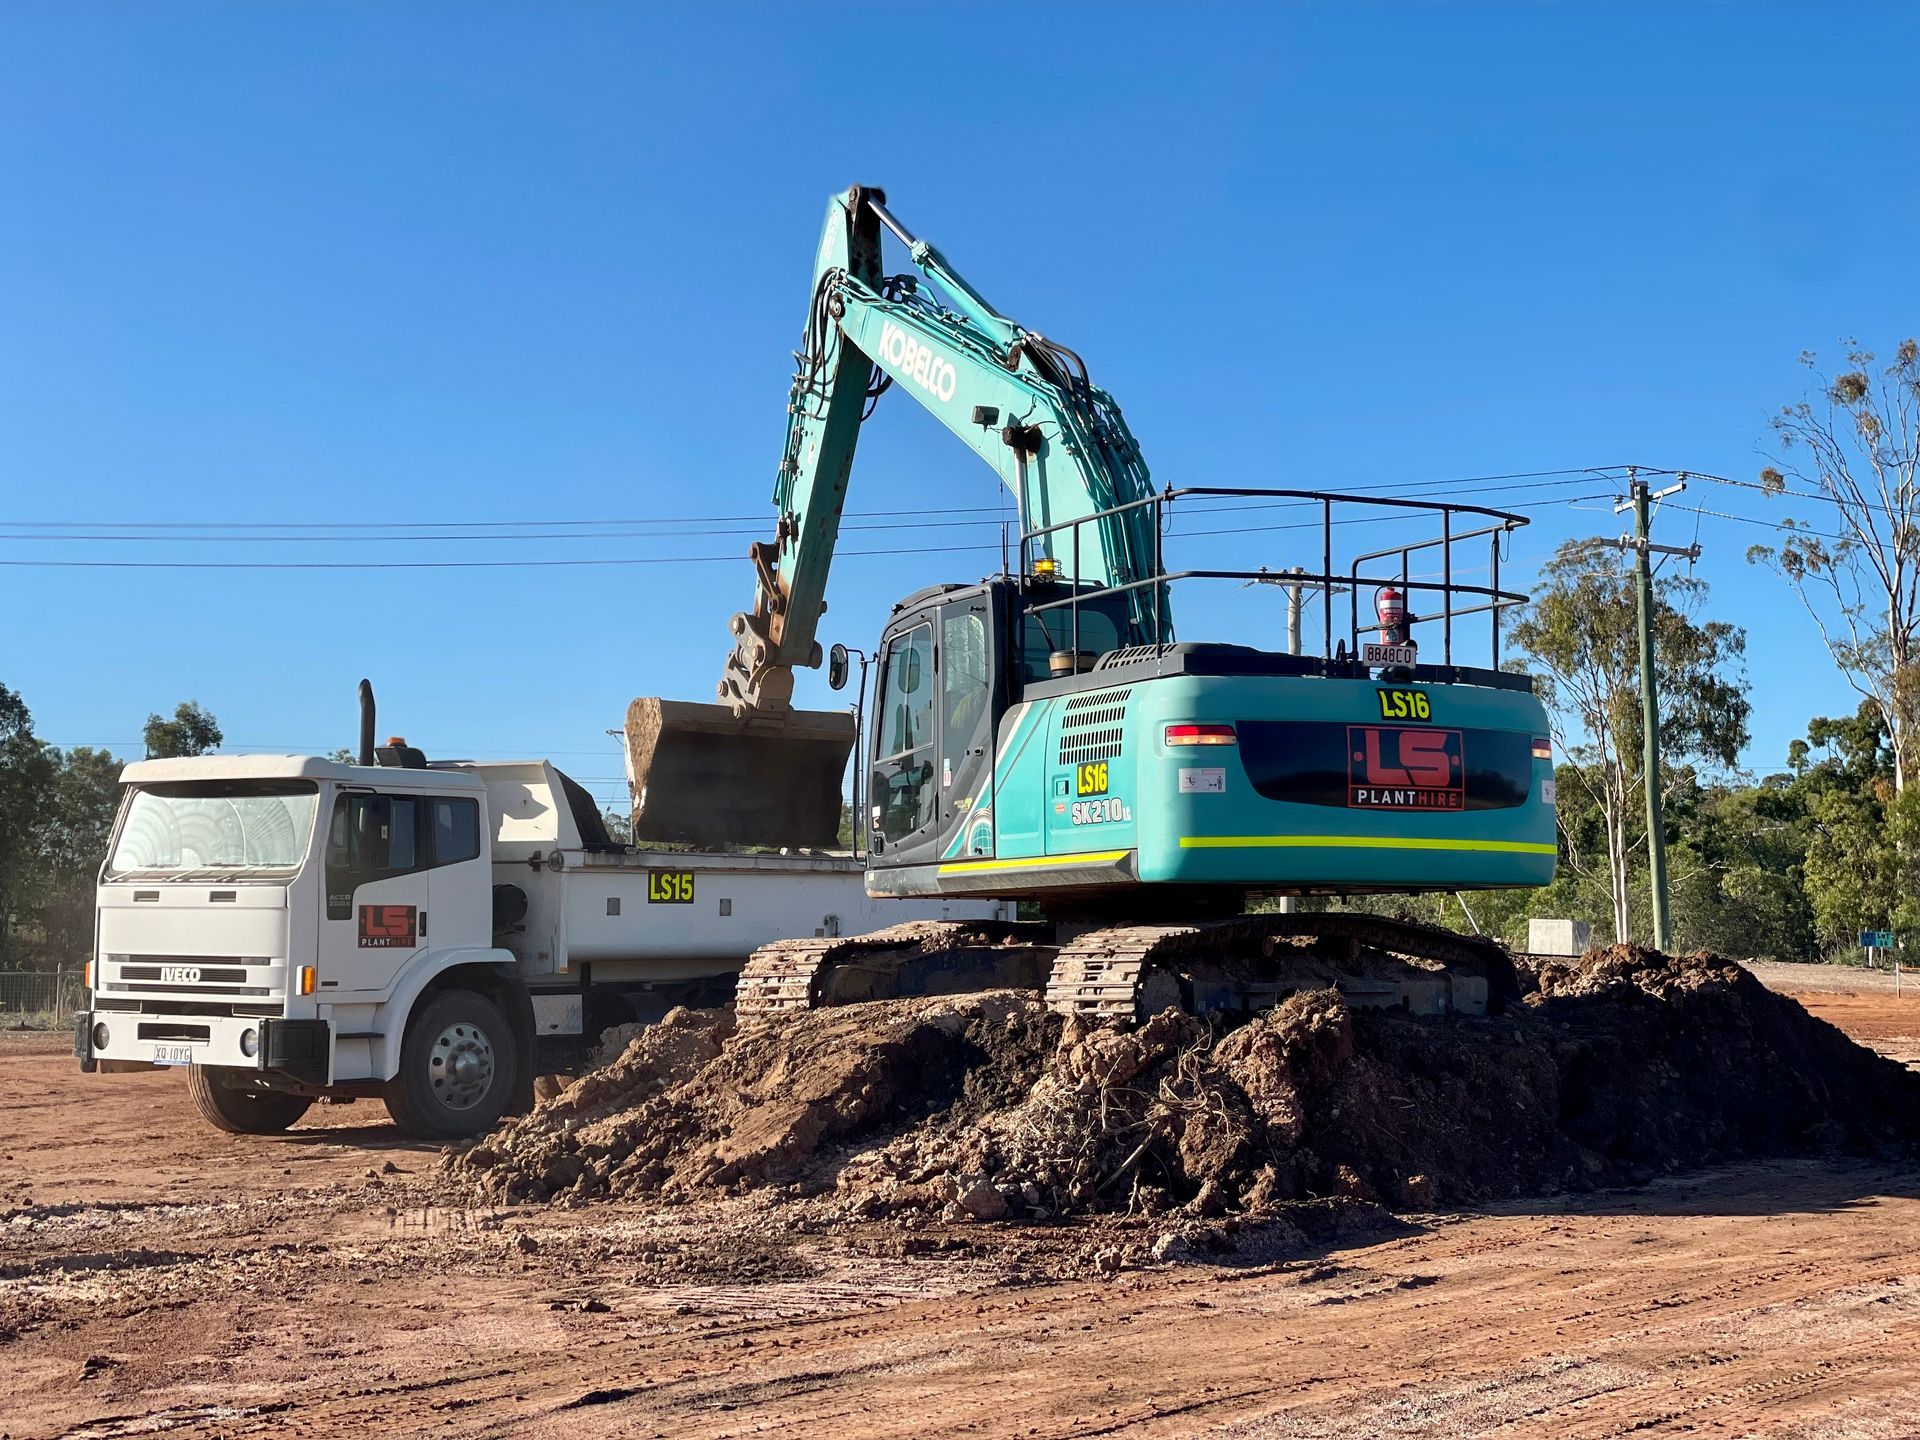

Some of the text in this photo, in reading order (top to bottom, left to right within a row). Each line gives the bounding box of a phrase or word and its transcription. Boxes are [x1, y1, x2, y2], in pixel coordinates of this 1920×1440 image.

[878, 320, 956, 402] KOBELCO
[1380, 690, 1430, 719] LS16
[1365, 730, 1450, 786] LS
[1078, 763, 1108, 795] LS16
[650, 873, 693, 900] LS15
[366, 907, 409, 935] LS
[160, 967, 201, 982] IVECO
